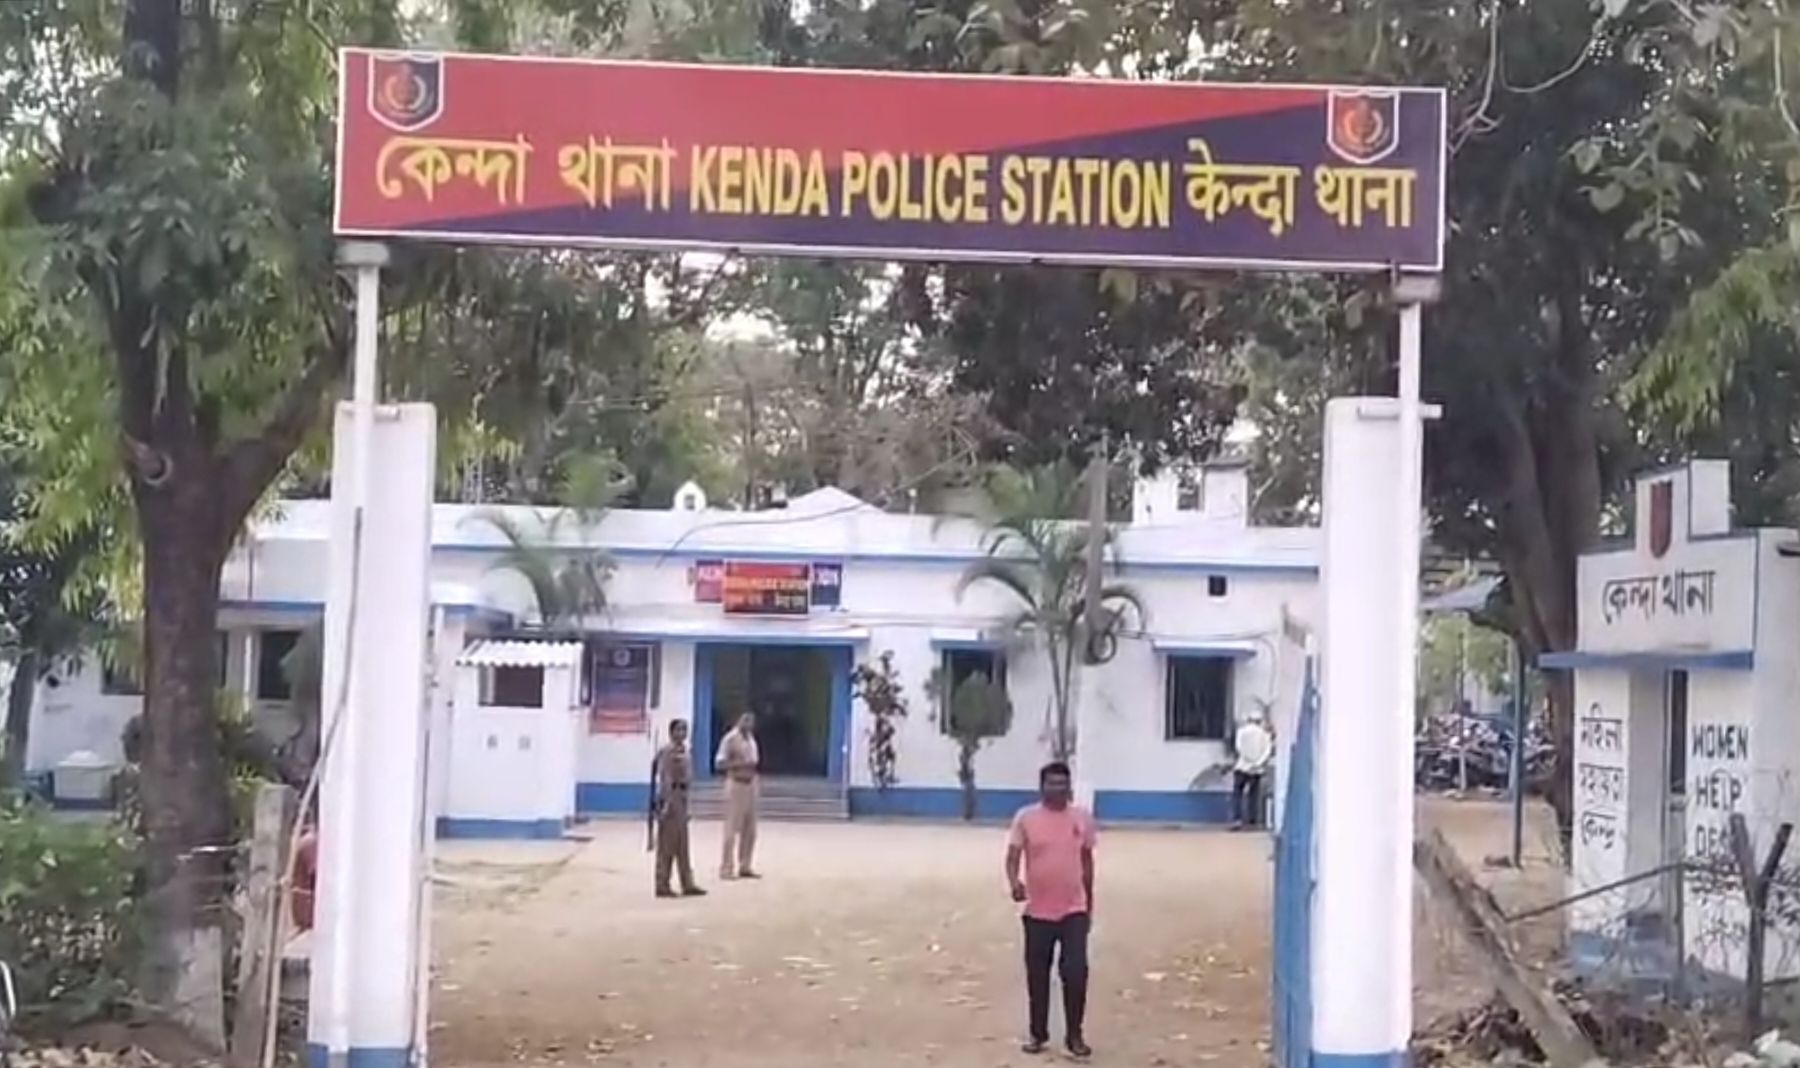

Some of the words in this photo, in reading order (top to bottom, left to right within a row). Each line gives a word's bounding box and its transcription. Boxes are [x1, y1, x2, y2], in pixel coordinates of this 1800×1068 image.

[376, 132, 534, 206] কেন্দা
[558, 134, 677, 212] থানা
[689, 145, 829, 217] KENDA
[841, 150, 989, 223] POLICE
[1001, 155, 1171, 229] STATION
[1184, 138, 1300, 238] केन्दा
[1313, 166, 1417, 229] थाना
[1602, 575, 1659, 625] কেন্দা
[1661, 568, 1716, 616] থানা
[1691, 724, 1749, 761] WOMEN
[1695, 774, 1743, 811] HELP
